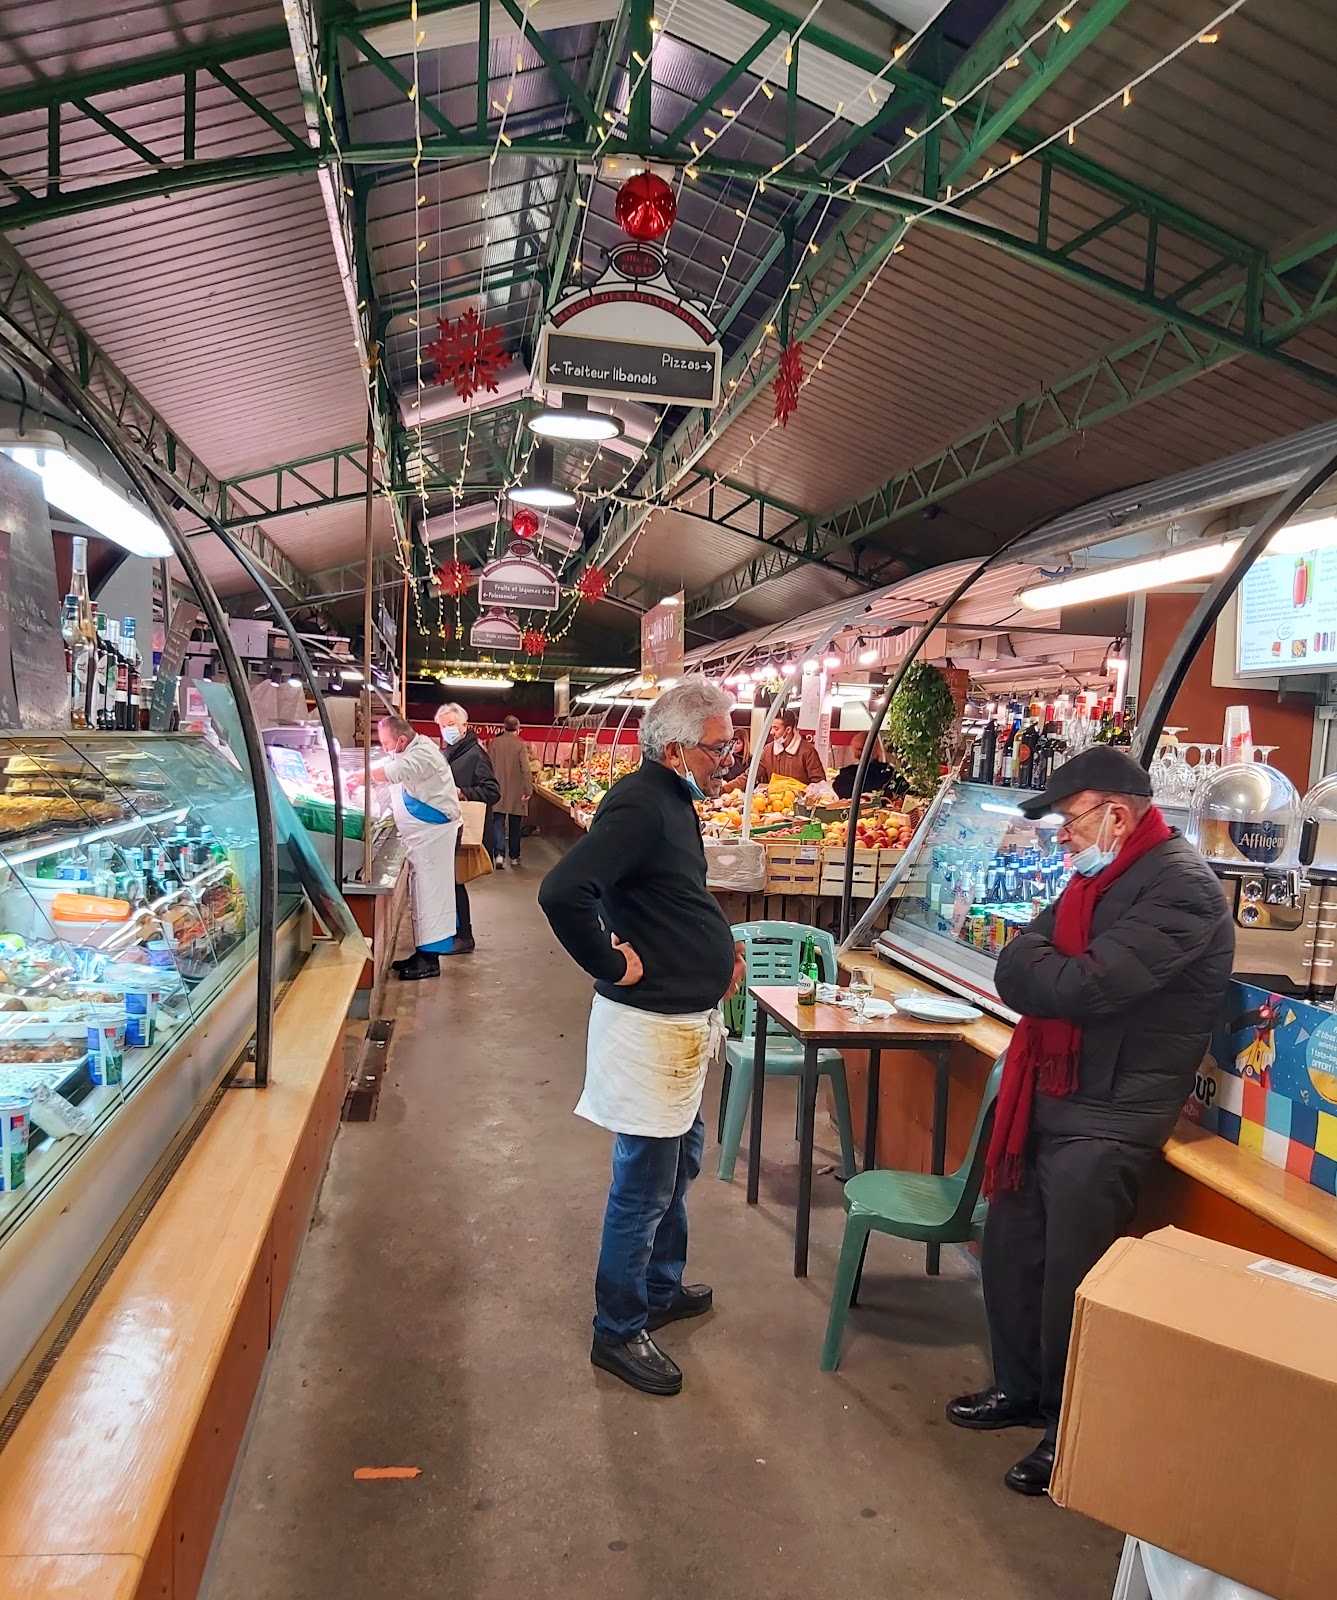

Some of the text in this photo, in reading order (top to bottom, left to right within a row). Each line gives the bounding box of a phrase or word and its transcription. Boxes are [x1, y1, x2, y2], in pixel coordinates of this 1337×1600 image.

[661, 353, 701, 371] Pizzas
[562, 361, 658, 385] Traiteur libanais
[494, 584, 510, 592] Fruits
[663, 612, 674, 641] BIO
[1238, 833, 1284, 851] Affligem
